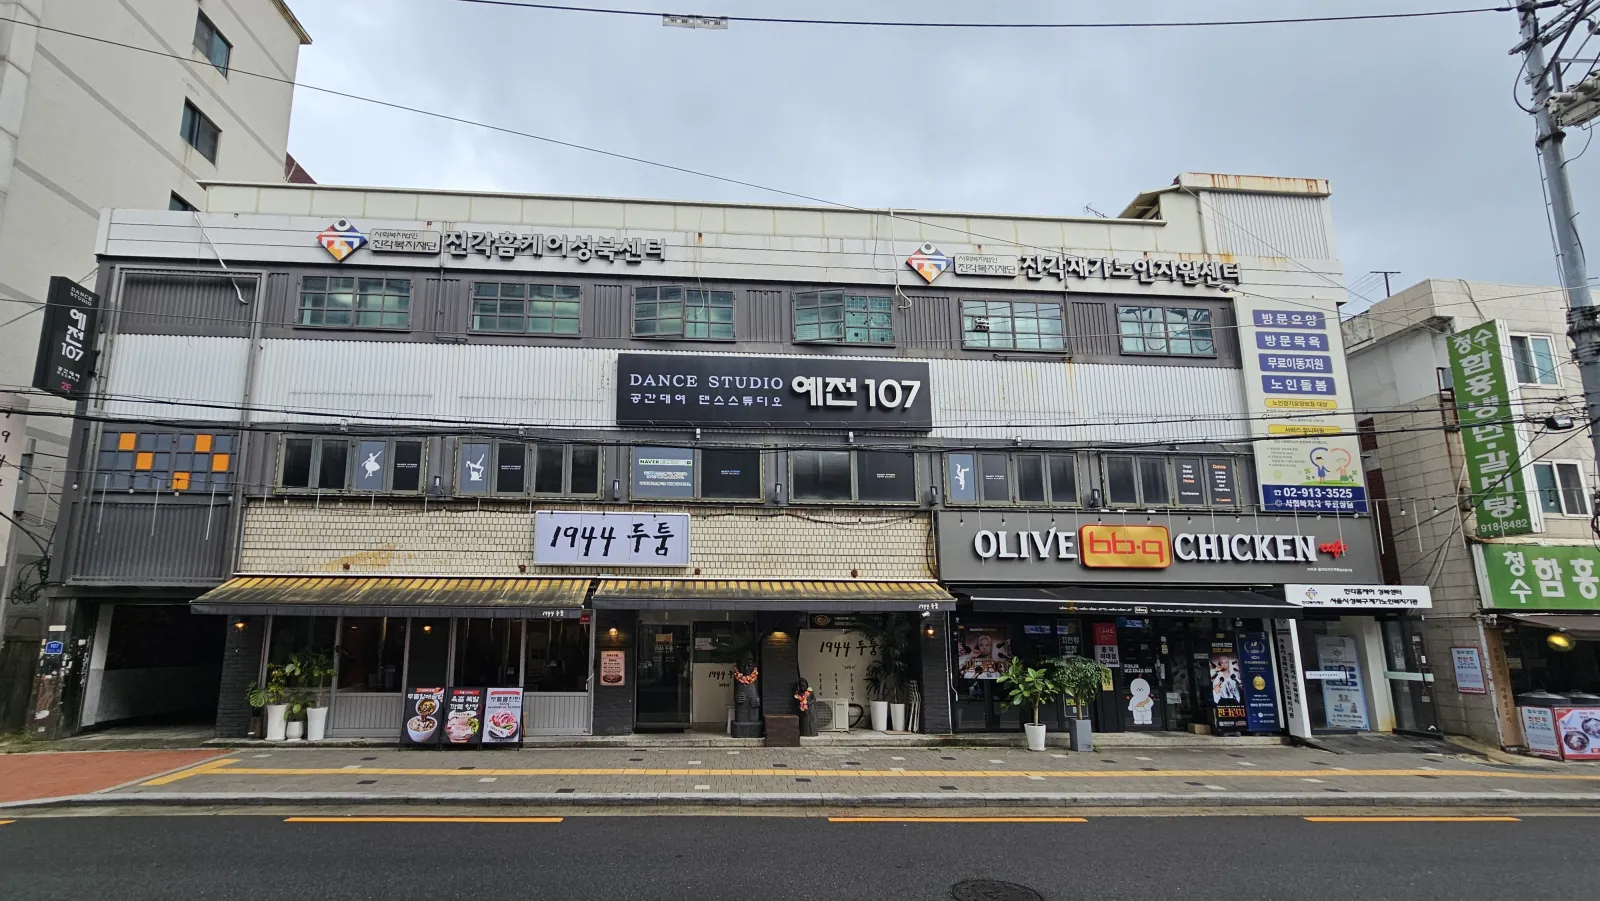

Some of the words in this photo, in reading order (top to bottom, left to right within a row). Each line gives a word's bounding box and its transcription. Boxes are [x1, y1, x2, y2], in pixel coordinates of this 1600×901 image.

[372, 238, 437, 251] 진각복지재단
[446, 229, 666, 263] 진각홈케어성북센터
[957, 262, 1017, 276] 진각복지재단
[69, 292, 92, 306] STUDIO
[70, 286, 93, 302] DANCE
[66, 308, 87, 348] 예전
[1261, 313, 1317, 327] 방문요양
[1264, 334, 1320, 348] 방문목욕
[61, 342, 84, 361] 107
[1267, 357, 1324, 370] 무료이동지원
[629, 373, 698, 388] DANCE
[708, 375, 784, 390] STUDIO
[1270, 379, 1328, 392] 노인돌봄
[791, 375, 858, 408] 예전
[864, 378, 921, 409] 107
[630, 393, 687, 405] 공간대여
[698, 394, 783, 408] 댄스스튜디오
[1283, 487, 1353, 499] 02-913-3525
[1481, 518, 1529, 534] 918-8482
[550, 526, 616, 557] 1944
[627, 522, 675, 557] 두툼
[974, 526, 1079, 559] OLIVE
[1174, 532, 1317, 563] CHICKEN
[1502, 550, 1533, 604] 청수
[819, 641, 852, 658] 1944
[708, 671, 727, 680] 1944
